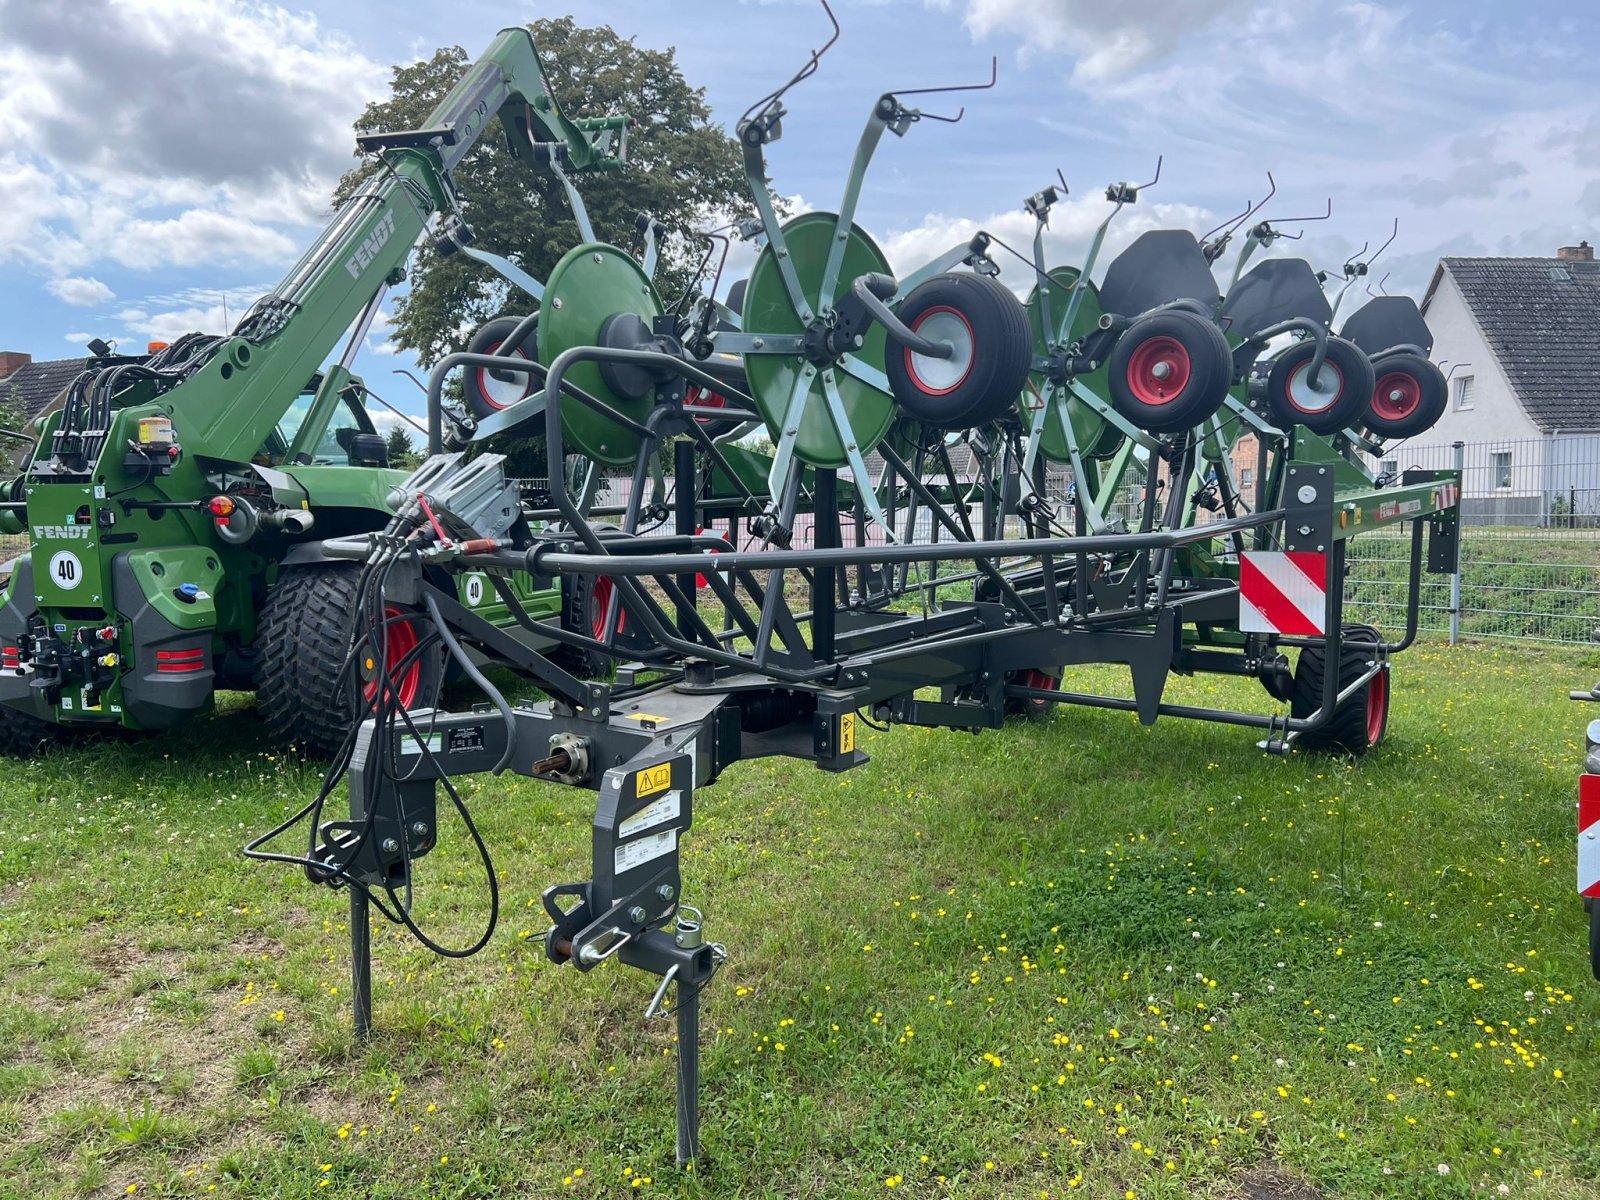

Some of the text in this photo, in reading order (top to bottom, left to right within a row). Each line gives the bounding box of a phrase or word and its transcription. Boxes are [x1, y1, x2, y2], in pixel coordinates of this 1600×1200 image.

[344, 208, 396, 280] FENDT
[33, 525, 92, 539] FENDT
[58, 560, 75, 580] 40
[470, 582, 479, 599] 40
